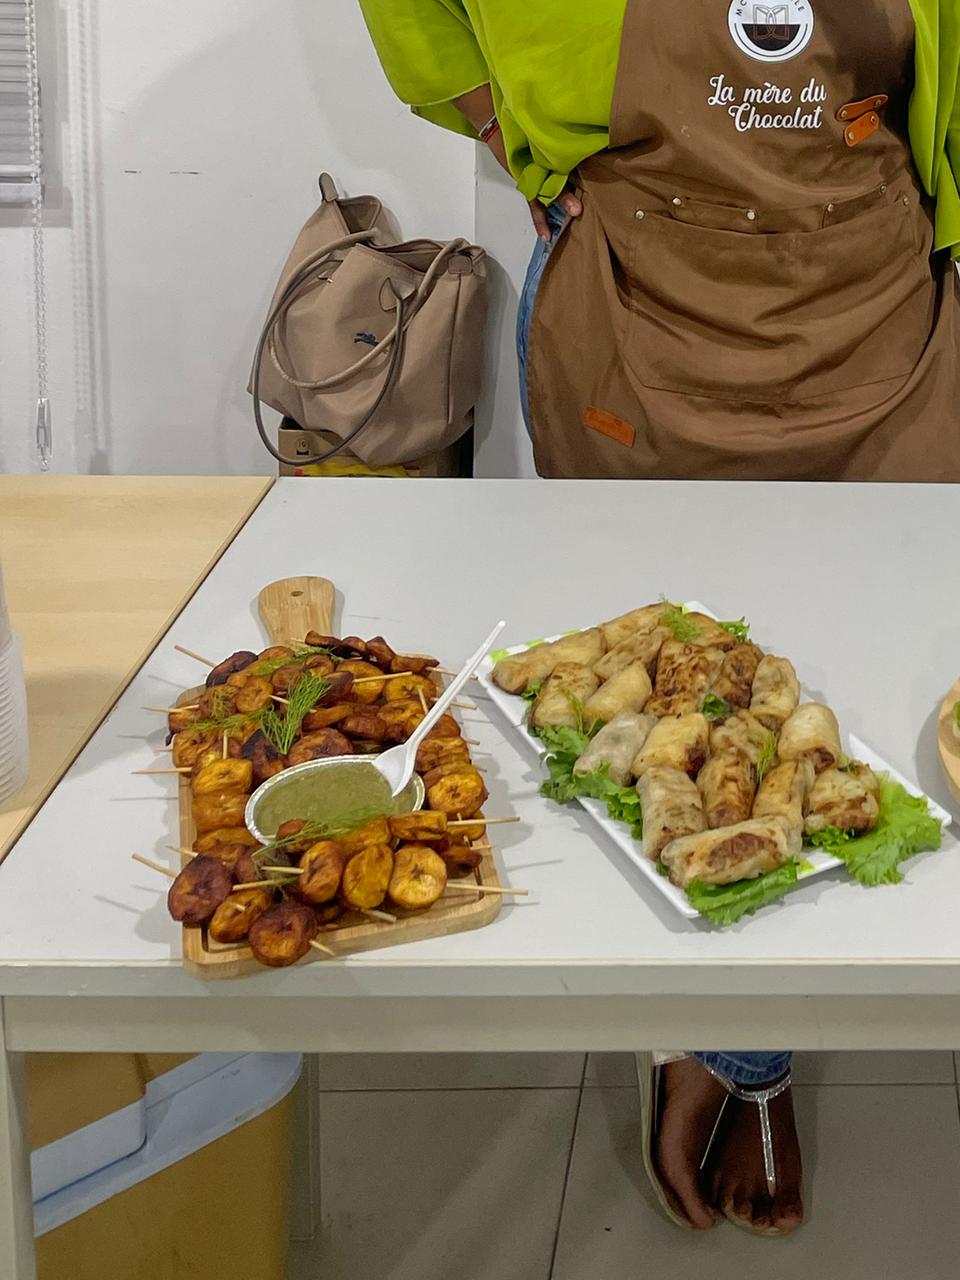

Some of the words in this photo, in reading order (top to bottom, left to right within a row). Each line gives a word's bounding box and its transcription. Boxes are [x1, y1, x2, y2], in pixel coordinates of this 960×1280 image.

[735, 0, 747, 17] MC
[707, 74, 736, 106] La
[743, 82, 793, 104] mère
[800, 78, 828, 103] du
[728, 103, 823, 132] Chocolat
